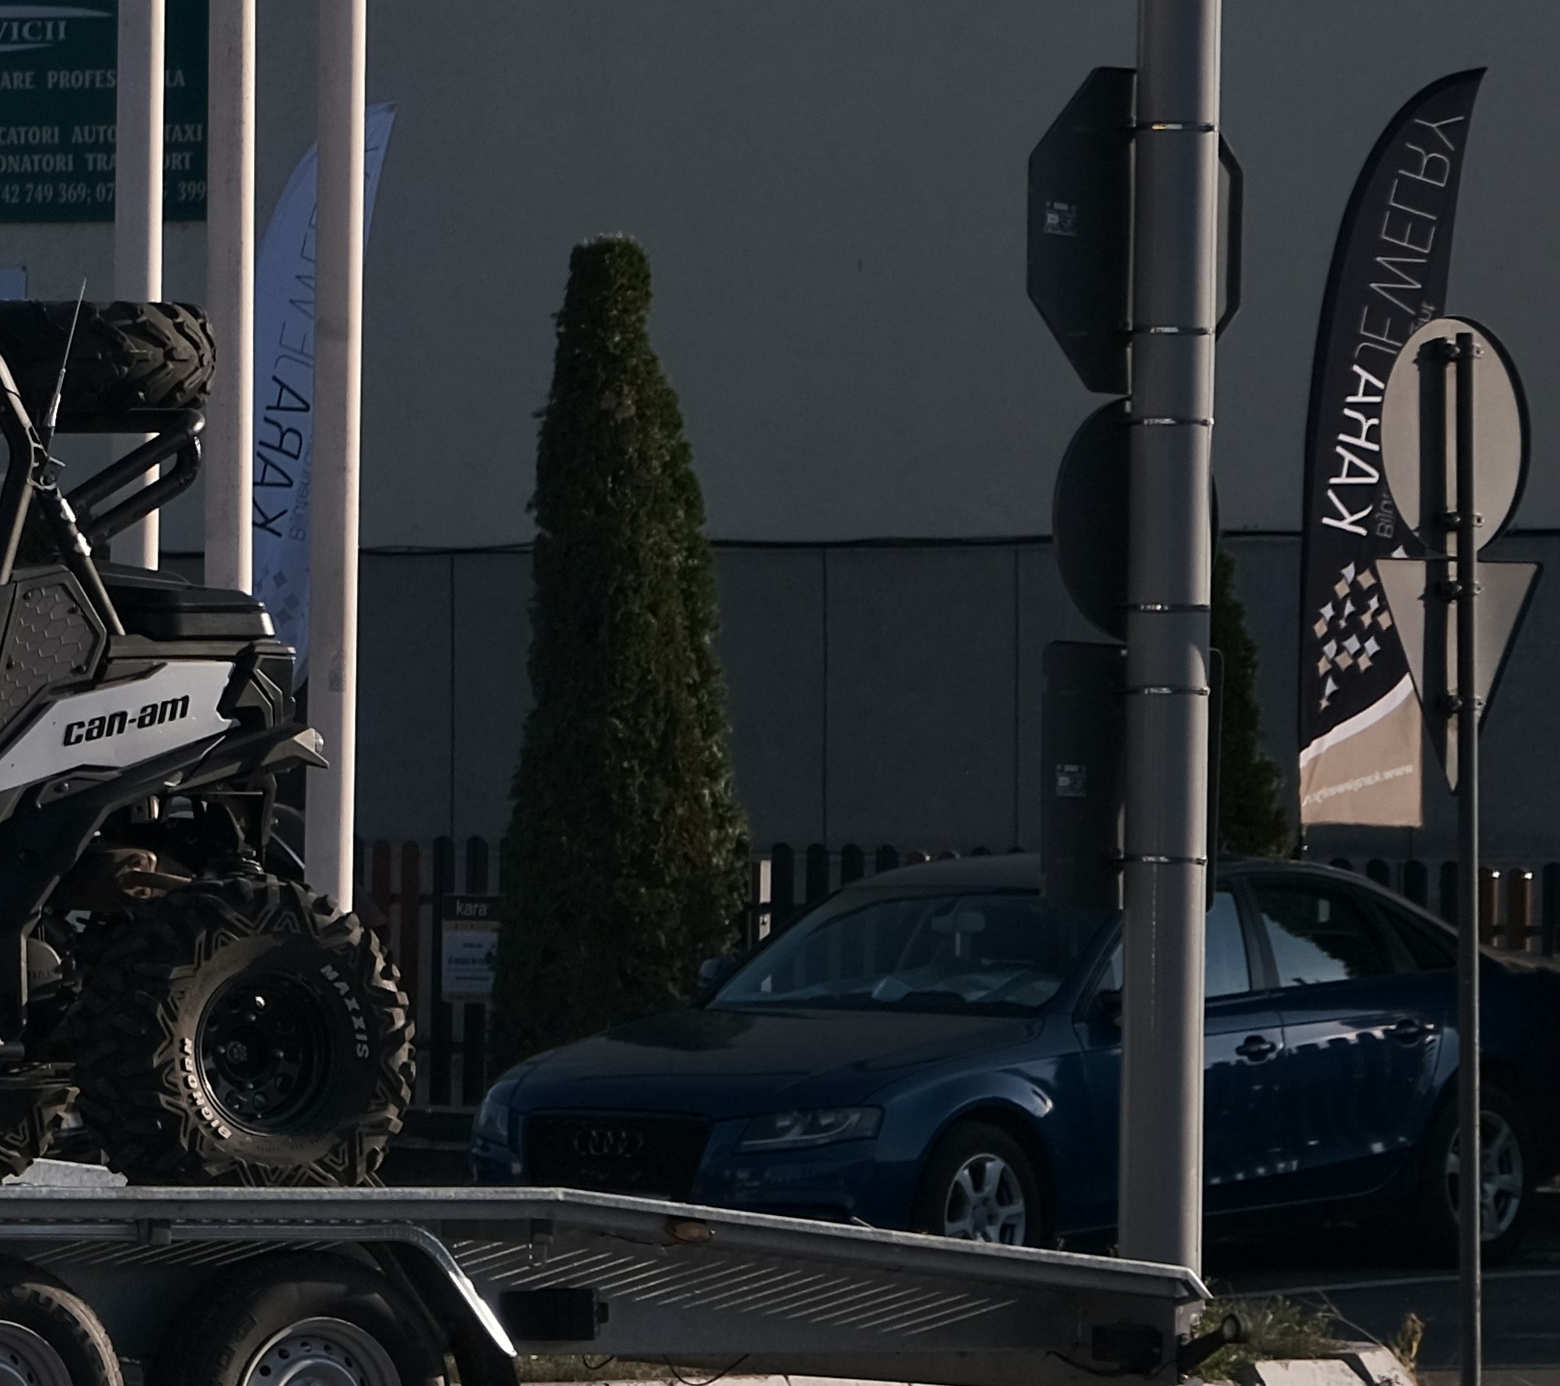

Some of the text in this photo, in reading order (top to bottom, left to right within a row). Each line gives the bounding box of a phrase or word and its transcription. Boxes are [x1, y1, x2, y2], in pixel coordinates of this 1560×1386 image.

[24, 182, 54, 205] 749
[63, 694, 190, 747] can-am
[320, 963, 370, 1061] MAXXIS
[180, 1036, 234, 1140] BIGHORN
